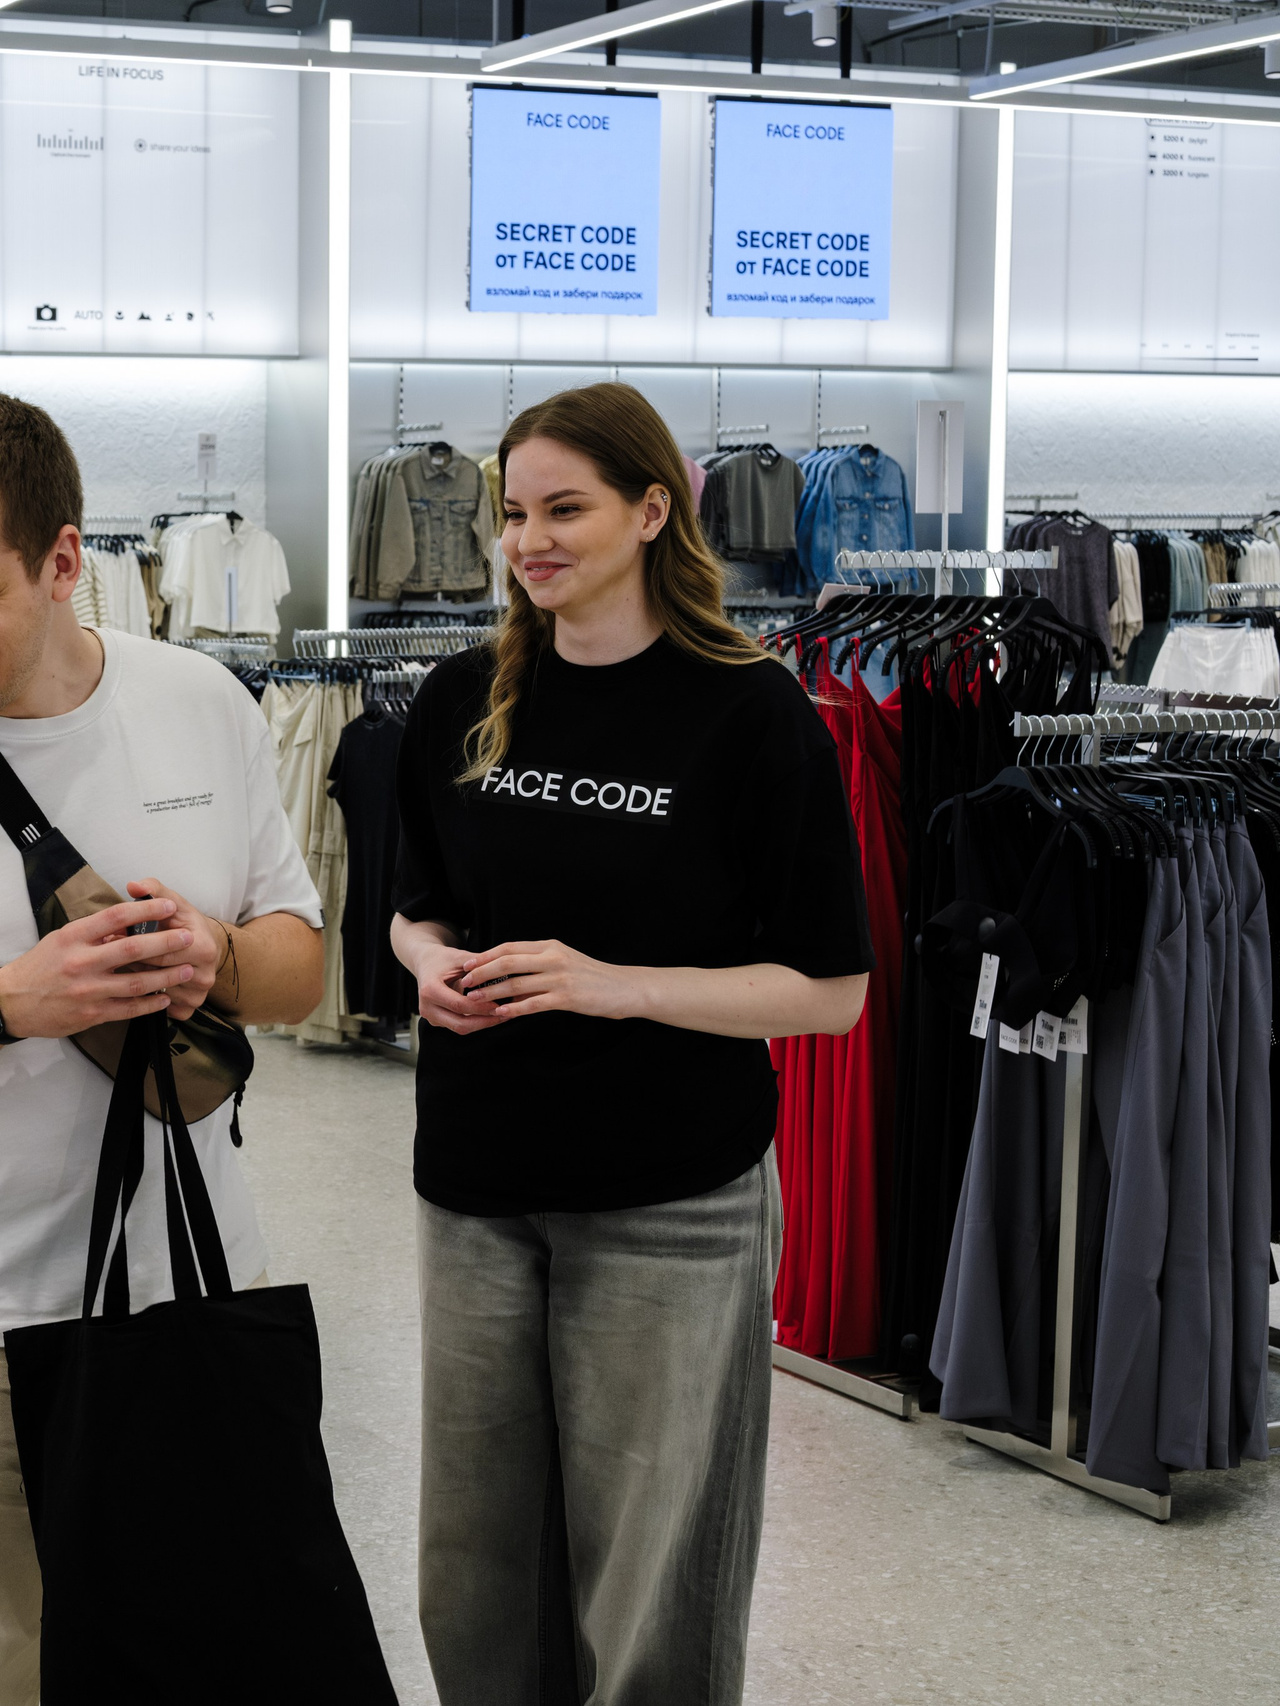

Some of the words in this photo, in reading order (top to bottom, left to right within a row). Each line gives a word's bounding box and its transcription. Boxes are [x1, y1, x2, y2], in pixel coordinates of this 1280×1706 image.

[78, 65, 105, 77] LIFE
[107, 67, 120, 78] IN
[123, 68, 164, 80] FOCUS
[527, 112, 563, 128] FACE
[567, 114, 610, 131] CODE
[767, 123, 801, 139] FACE
[804, 125, 845, 141] CODE
[496, 222, 576, 243] SECRET
[581, 226, 637, 245] CODE
[736, 230, 812, 250] SECRET
[817, 233, 870, 252] CODE
[495, 254, 517, 269] от
[524, 251, 575, 270] FACE
[581, 252, 637, 272] CODE
[736, 260, 757, 275] от
[762, 257, 811, 277] FACE
[816, 259, 870, 278] CODE
[486, 286, 530, 297] взломай
[533, 288, 551, 299] код
[553, 289, 560, 297] и
[563, 287, 598, 301] забери
[601, 289, 643, 301] подарок
[727, 291, 769, 302] взломай
[771, 293, 789, 304] код
[790, 294, 797, 302] и
[799, 292, 834, 306] забери
[835, 295, 876, 306] подарок
[74, 310, 103, 320] AUTO
[480, 767, 564, 802] FACE
[570, 778, 672, 816] CODE
